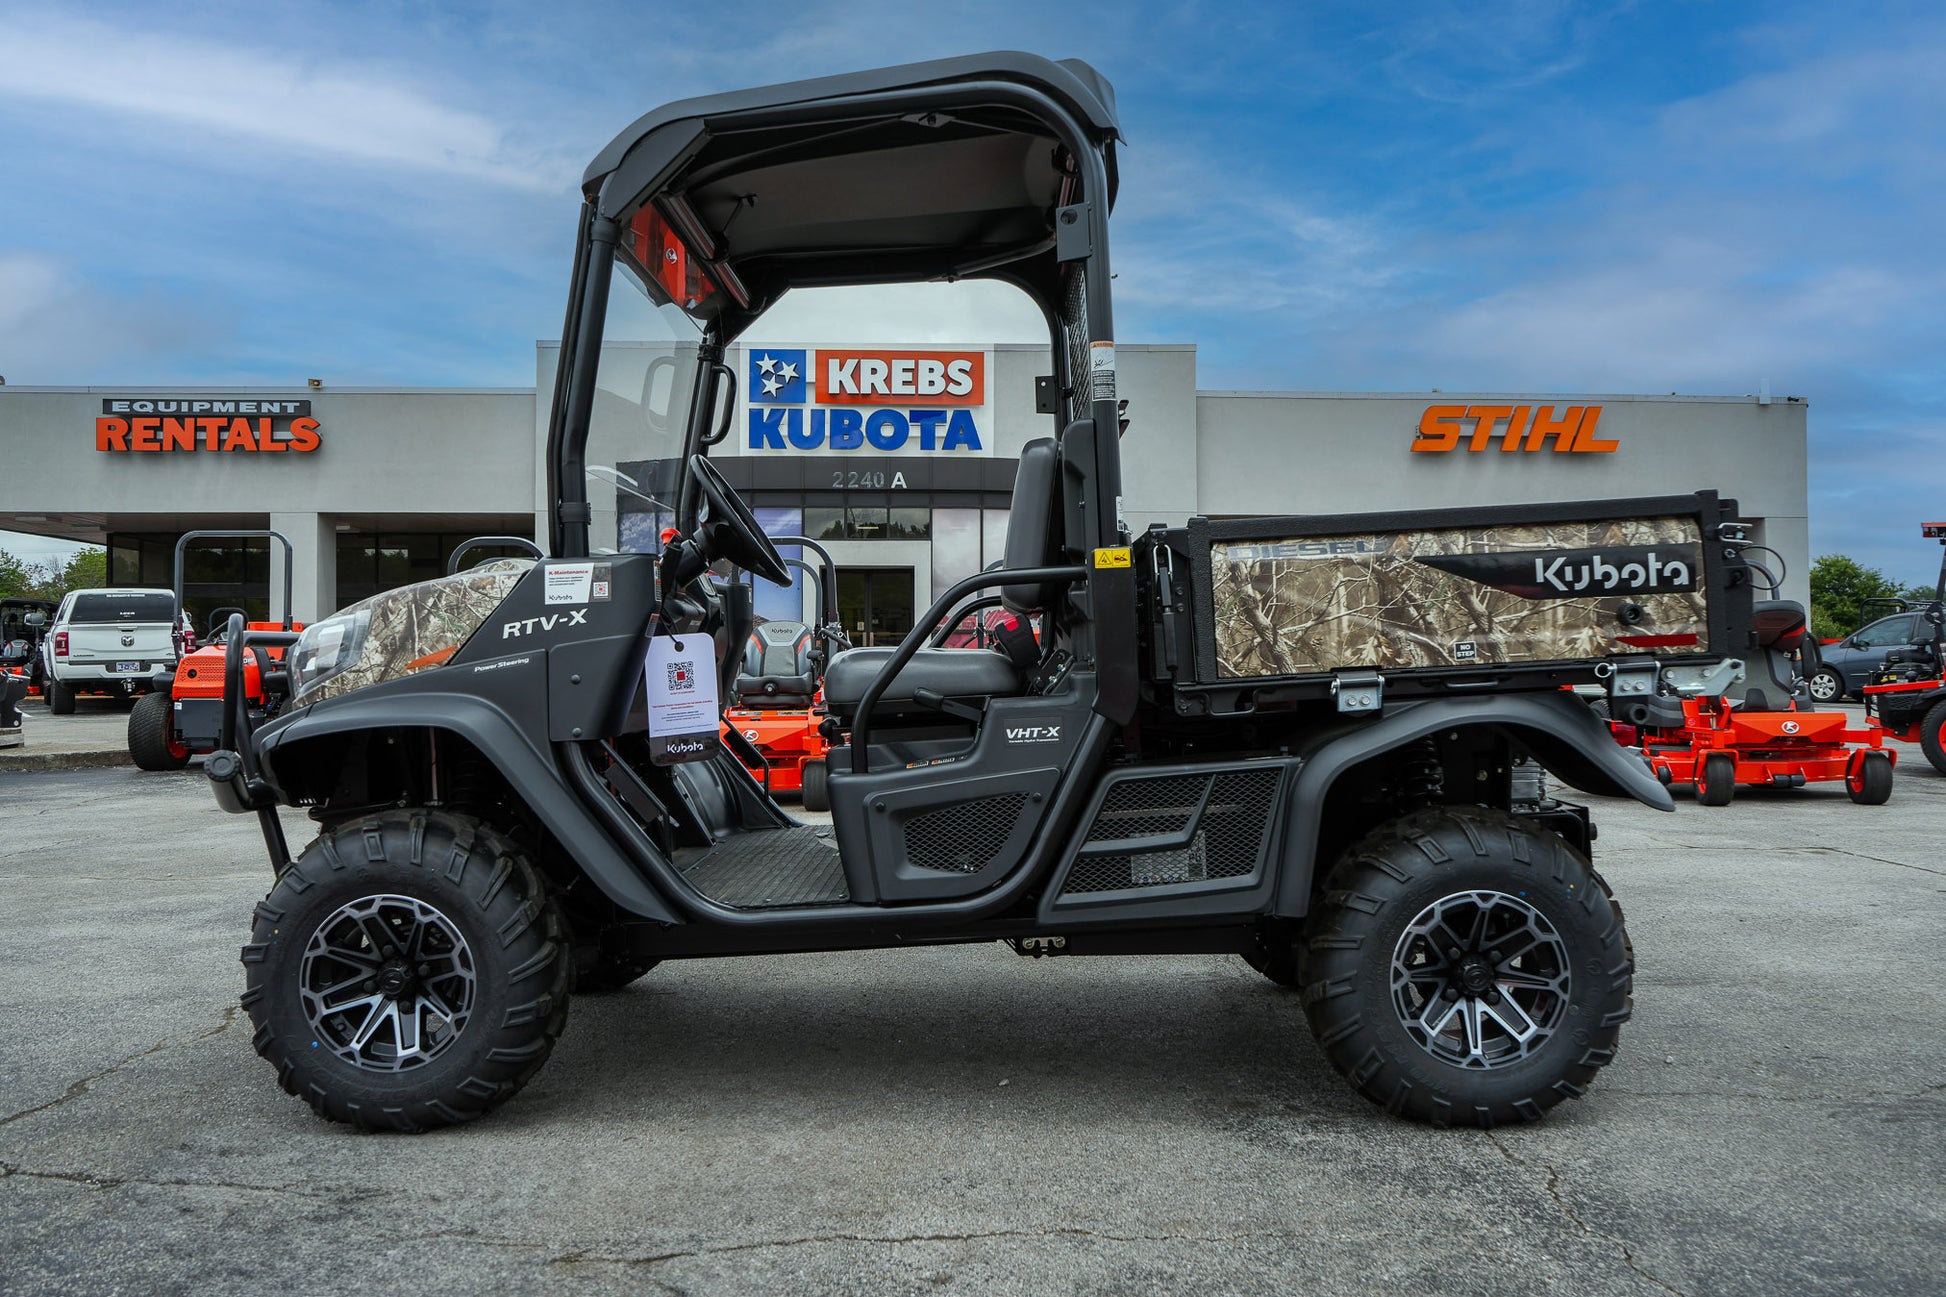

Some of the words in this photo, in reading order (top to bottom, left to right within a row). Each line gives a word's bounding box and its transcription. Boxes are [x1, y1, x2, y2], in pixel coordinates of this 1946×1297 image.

[827, 358, 973, 396] KREBS
[111, 401, 300, 413] EQUIPMENT
[95, 416, 321, 452] RENTALS
[748, 408, 983, 451] KUBOTA
[1410, 405, 1620, 453] STIHL
[832, 471, 885, 489] 2240
[890, 471, 908, 489] A
[1228, 540, 1387, 561] DIESEL
[1534, 552, 1689, 591] Kubota
[502, 608, 589, 639] RTV-X
[474, 663, 498, 673] Power
[497, 658, 530, 668] Steering
[1006, 726, 1061, 739] VHT-X
[666, 741, 704, 754] Kubota
